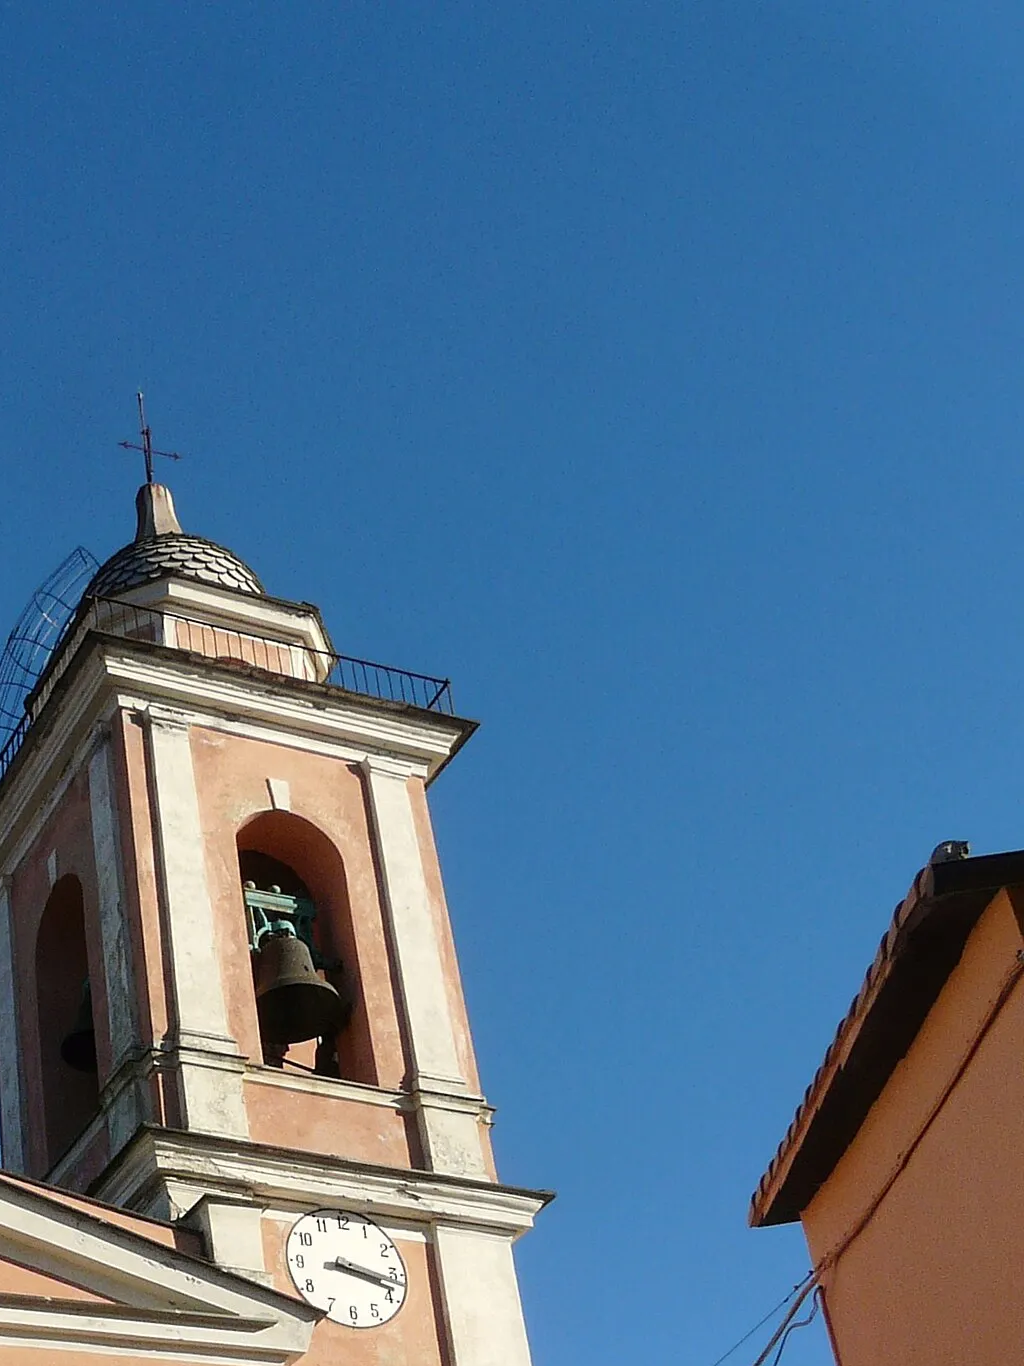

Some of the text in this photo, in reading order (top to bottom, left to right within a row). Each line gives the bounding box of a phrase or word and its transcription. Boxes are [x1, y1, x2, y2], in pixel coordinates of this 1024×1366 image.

[316, 1219, 327, 1233] 11
[337, 1215, 350, 1231] 12
[299, 1232, 313, 1246] 10
[362, 1225, 368, 1239] 1
[380, 1244, 389, 1258] 2
[295, 1254, 305, 1269] 9
[388, 1267, 397, 1281] 3
[305, 1278, 315, 1293] 8
[384, 1289, 393, 1304] 4
[327, 1298, 336, 1312] 7
[370, 1303, 379, 1318] 5
[349, 1305, 358, 1320] 6
